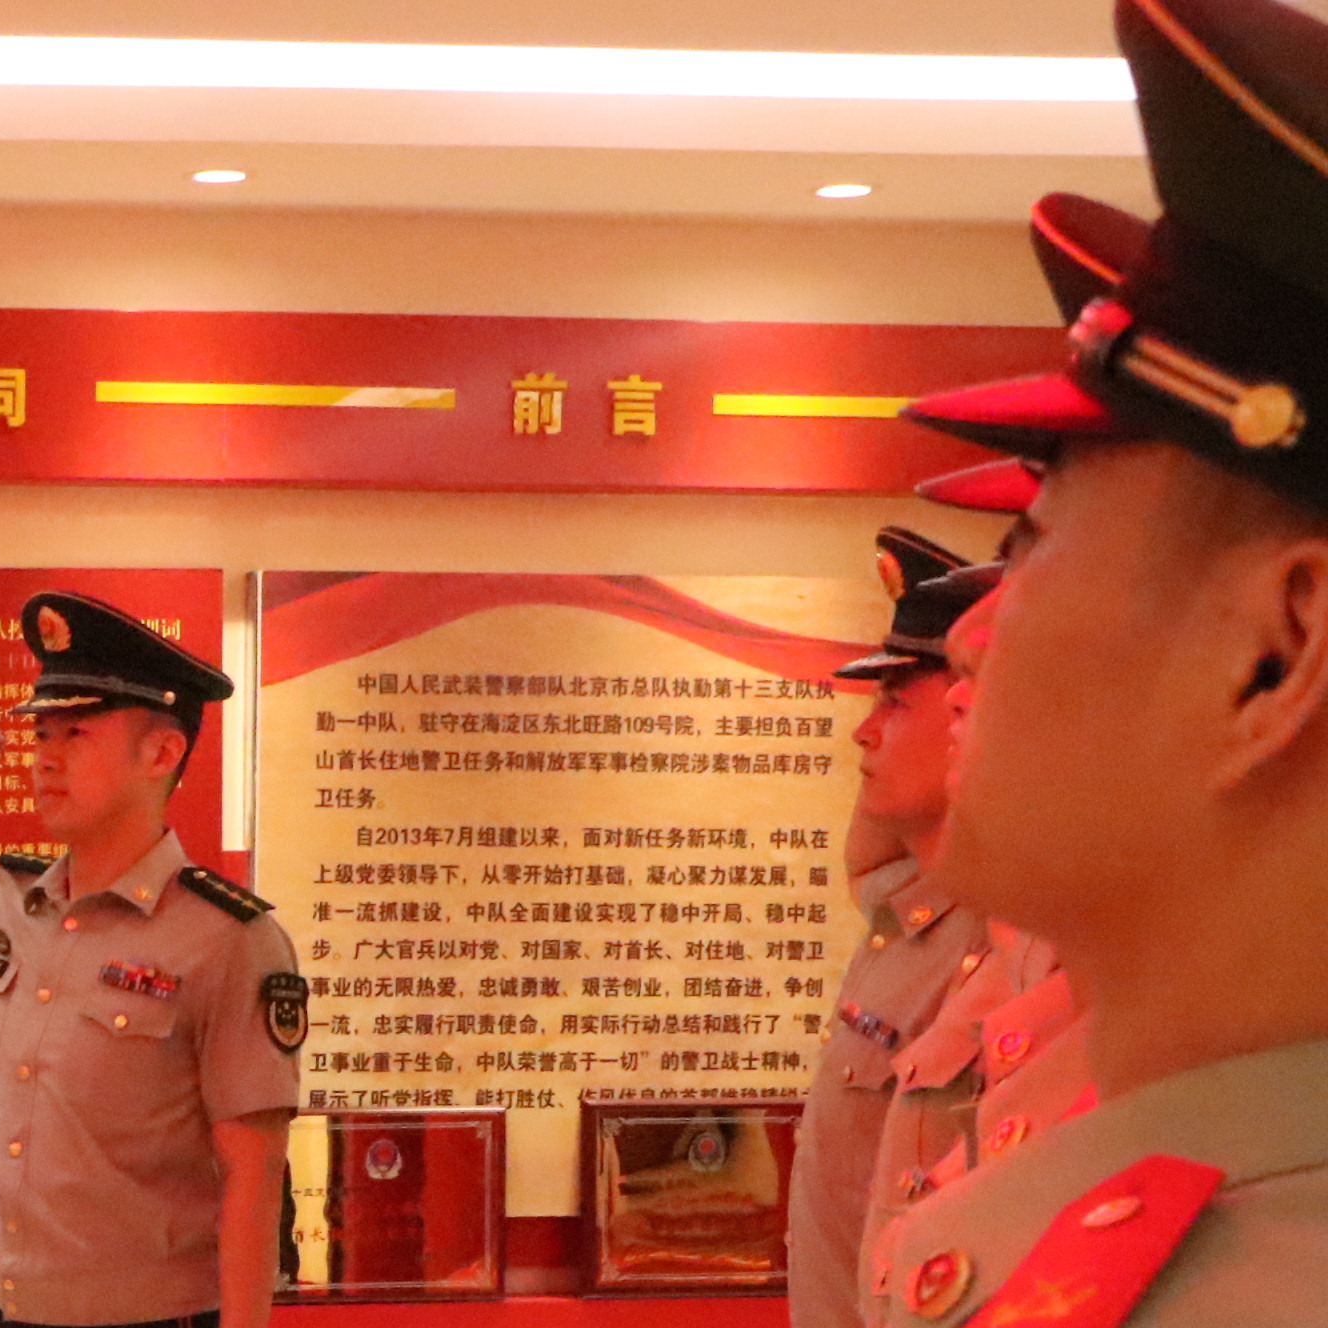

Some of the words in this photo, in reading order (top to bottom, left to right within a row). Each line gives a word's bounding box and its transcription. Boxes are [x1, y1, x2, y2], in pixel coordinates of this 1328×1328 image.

[511, 371, 664, 437] 前言
[357, 674, 835, 701] 中国人民武装警察部队北京市总队执勤第十三支队执
[315, 750, 833, 777] 山首长住地警卫任务和解放军军事检察院涉案物品库房守
[314, 787, 386, 811] 卫任务。
[356, 825, 829, 849] 自2013年7月组建以来，面对新任务新环境，中队在
[313, 863, 829, 888] 上级党委领导下，从零开始打基础，凝心聚力谋发展，瞄
[312, 901, 828, 925] 准一流抓建设，中队全面建设实现了稳中开局、稳中起
[312, 938, 825, 962] 步。广大官兵以对党、对国家、对首长、对住地、对警卫
[310, 975, 824, 998] 事业的无限热爱，忠诚勇敢、艰苦创业，团结奋进，争创
[309, 1049, 812, 1075] 卫事业重于生命，中队荣誉高于一切”的警卫战士精神，
